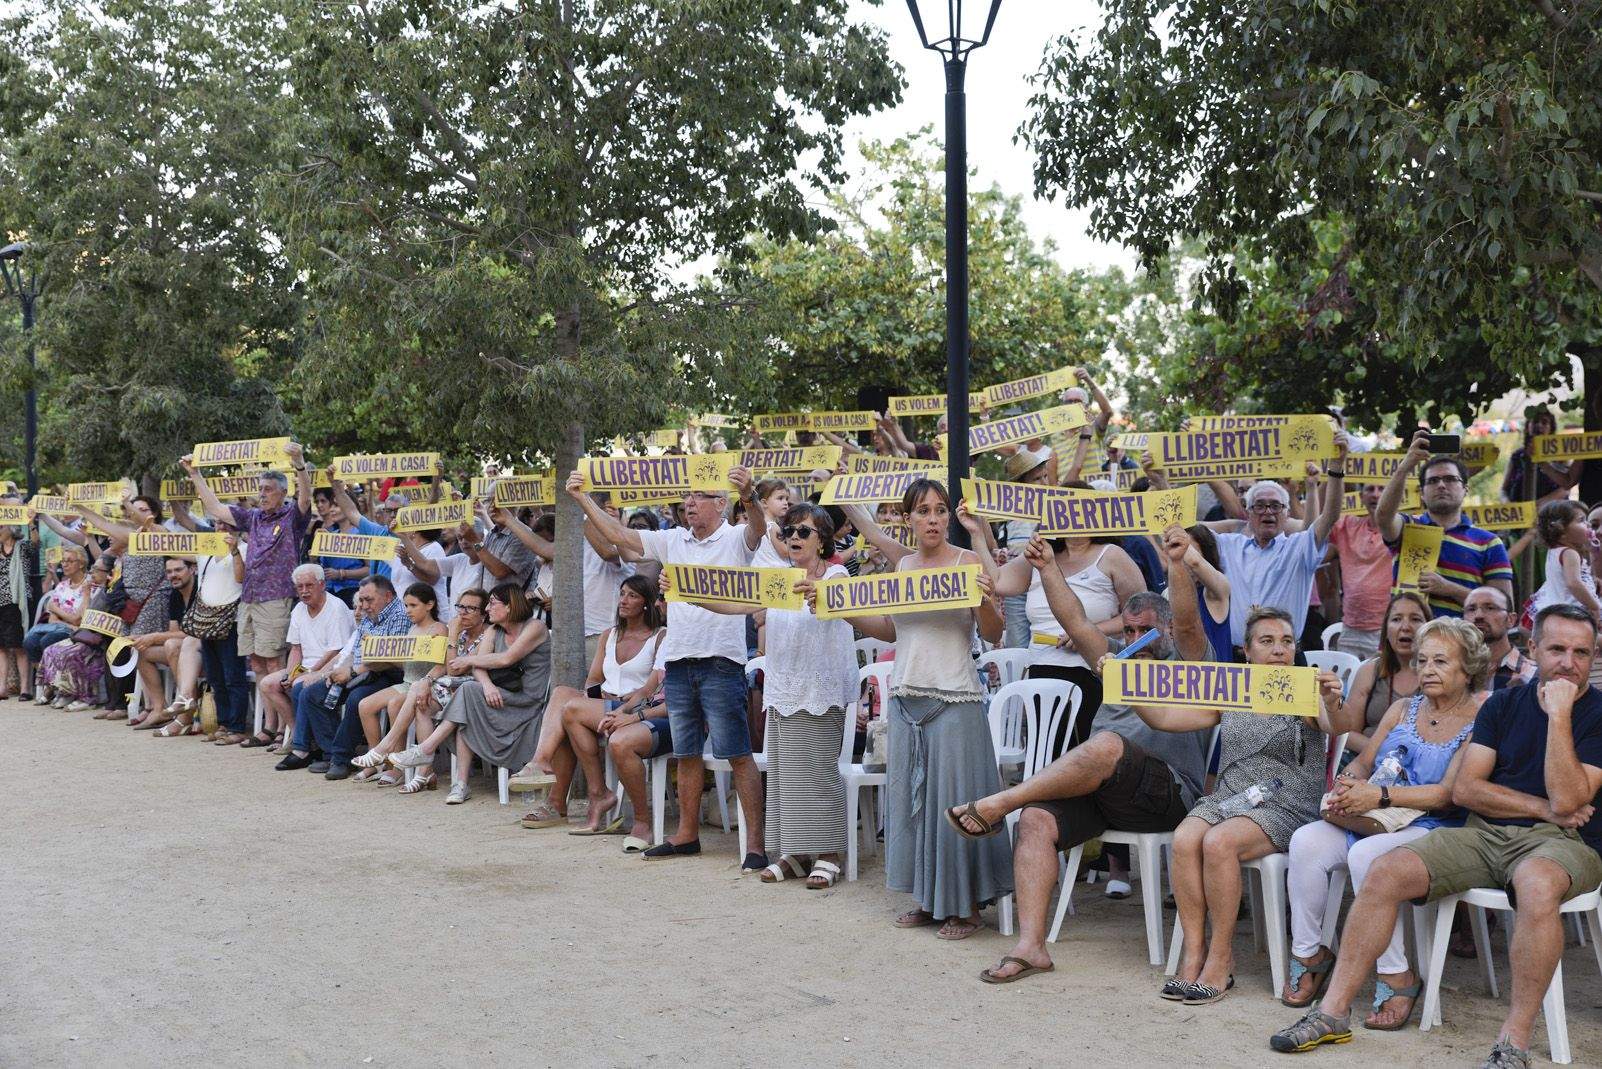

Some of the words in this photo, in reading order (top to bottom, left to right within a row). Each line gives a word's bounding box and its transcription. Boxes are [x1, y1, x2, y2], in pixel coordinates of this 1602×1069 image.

[989, 375, 1050, 403] LLIBERTAT!
[895, 398, 908, 411] US
[909, 396, 940, 410] VOLEM
[760, 417, 770, 428] US
[773, 416, 799, 427] VOLEM
[814, 417, 822, 427] US
[823, 415, 844, 427] VOLEM
[845, 415, 850, 425] A
[850, 413, 869, 425] CASA!
[969, 413, 1046, 449] IBERTAT!
[200, 441, 260, 462] LLIBERTAT!
[1163, 428, 1281, 463] LLIBERTAT!
[1542, 439, 1558, 455] US
[341, 460, 353, 474] US
[356, 458, 388, 473] VOLEM
[391, 458, 398, 472] A
[400, 456, 429, 471] CASA!
[740, 449, 804, 468] IBERTAT!
[855, 458, 869, 473] US
[1368, 458, 1377, 475] A
[590, 458, 690, 486] LLIBERTAT!
[73, 484, 108, 501] LLIBERTAT!
[496, 481, 544, 502] LLIBERTAT!
[834, 472, 928, 499] LLIBERTA
[400, 510, 410, 526] US
[411, 508, 437, 525] VOLEM
[437, 508, 443, 522] A
[443, 504, 466, 522] CASA!
[1472, 509, 1480, 524] A
[1484, 506, 1524, 524] CASA!
[136, 533, 198, 552] LLIBERTAT!
[318, 534, 372, 555] LLIBERTAT!
[675, 566, 760, 600] LLIBERTAT!
[826, 585, 845, 609] US
[848, 578, 900, 606] VOLEM
[904, 578, 915, 601] A
[919, 571, 968, 601] CASA!
[363, 636, 416, 659] LLIBERTAT!
[1121, 662, 1251, 704] LLIBERTAT!
